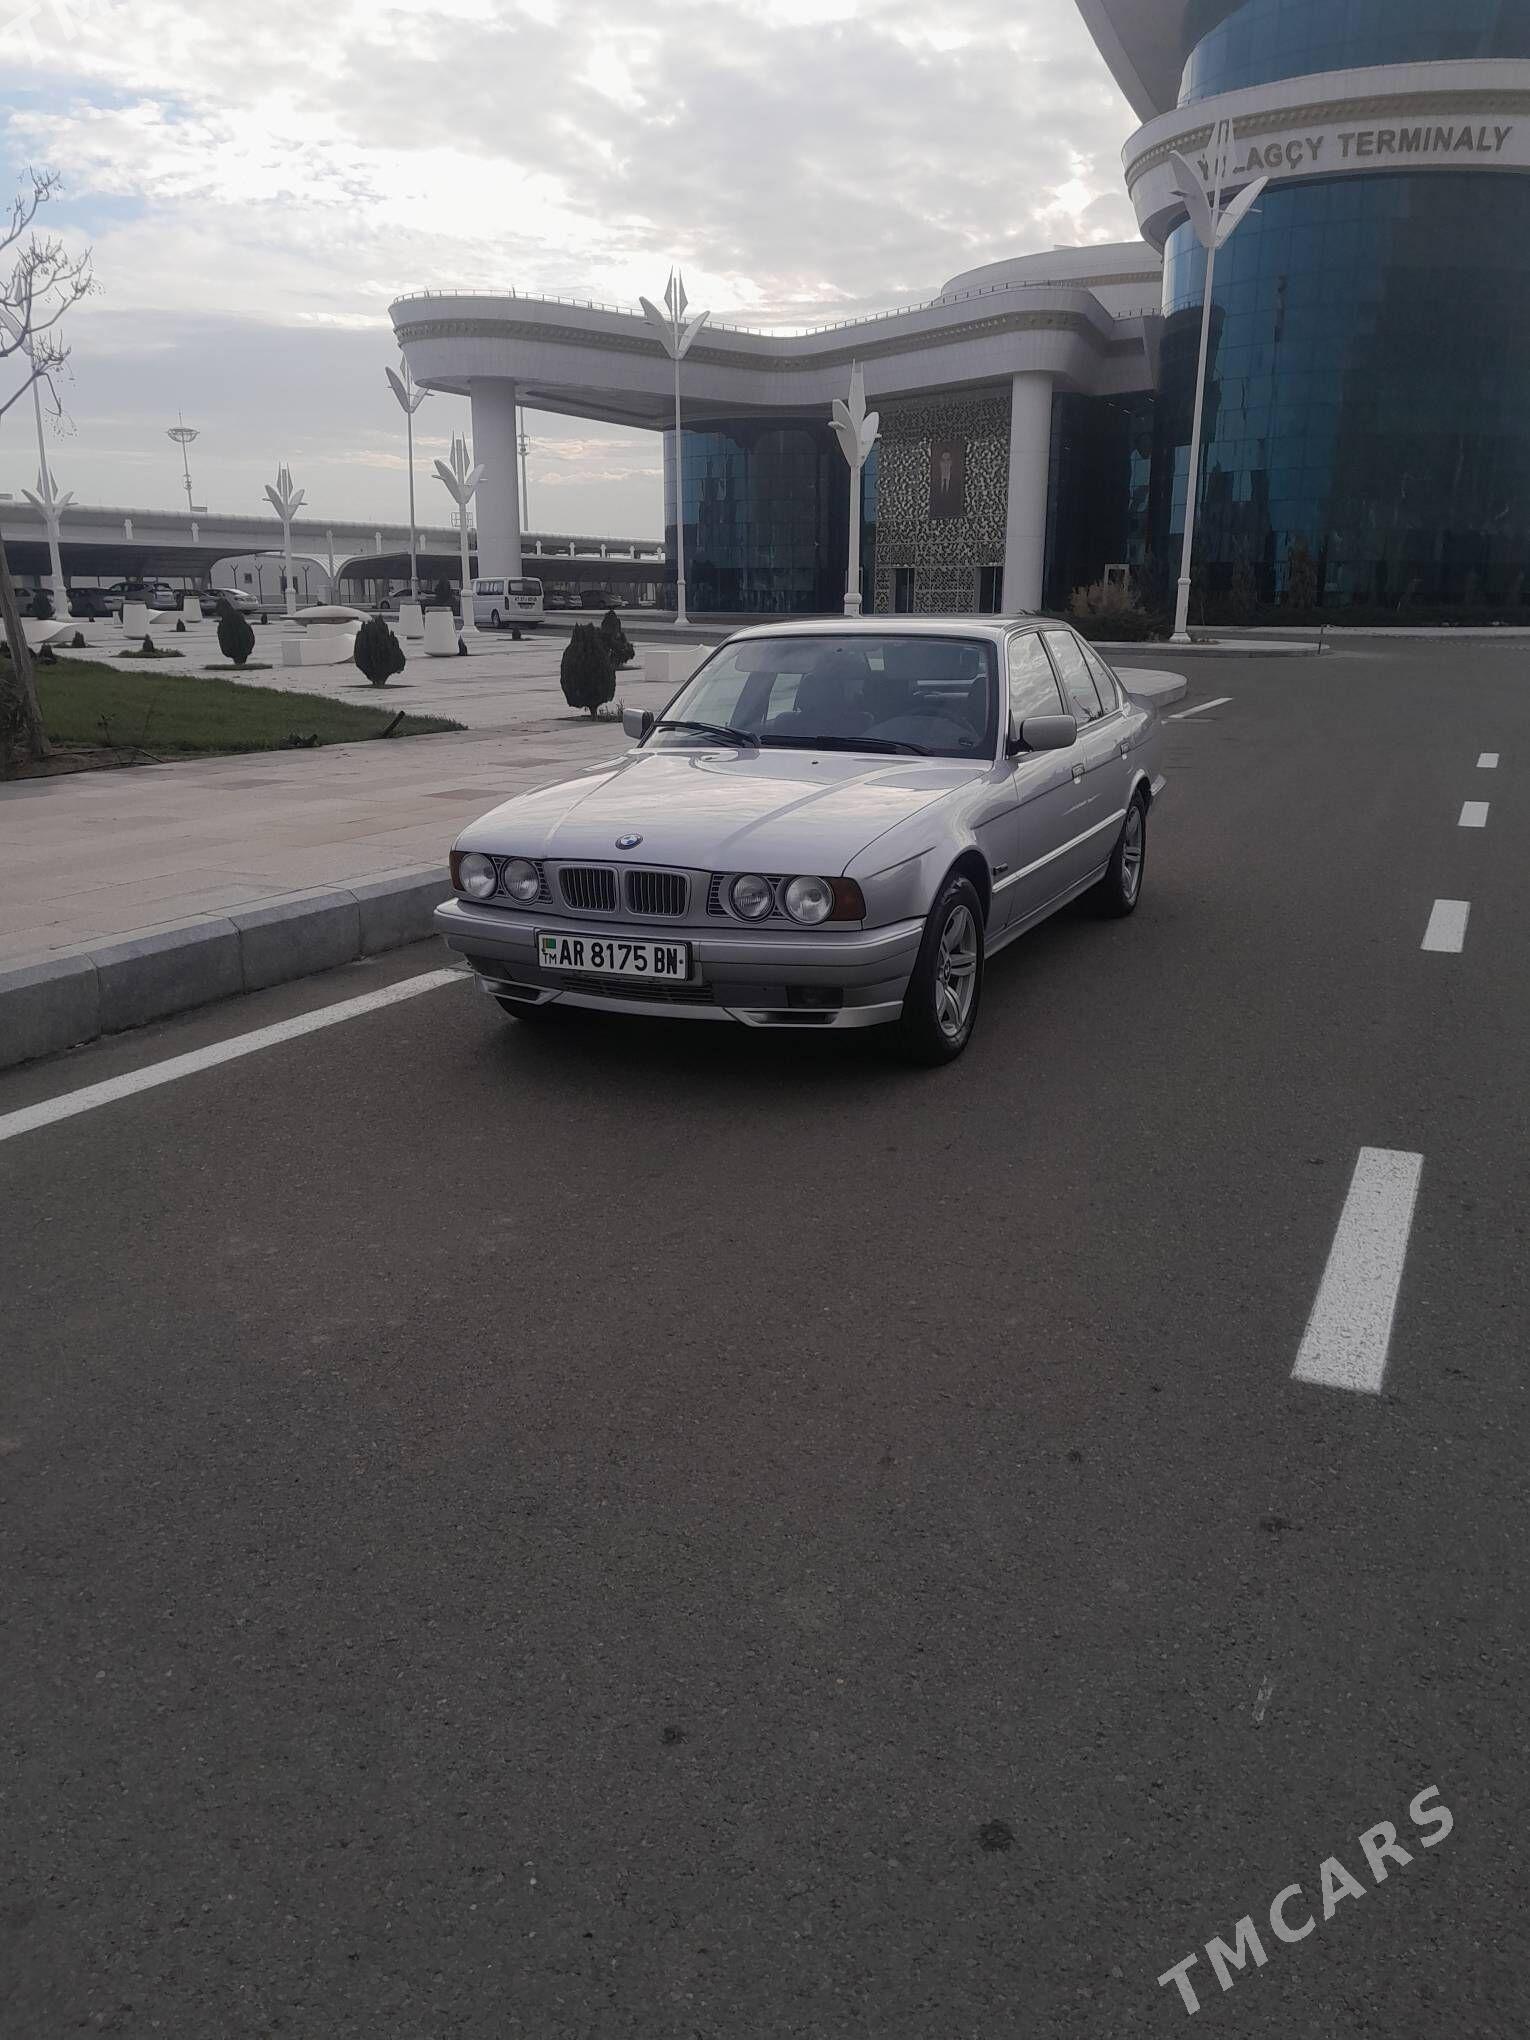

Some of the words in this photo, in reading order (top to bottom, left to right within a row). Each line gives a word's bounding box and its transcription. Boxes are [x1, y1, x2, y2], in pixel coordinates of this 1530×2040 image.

[1336, 125, 1513, 158] TERMINALY
[543, 952, 557, 965] TM
[559, 939, 584, 966] AR
[591, 941, 648, 972] 8175
[654, 946, 678, 975] BN
